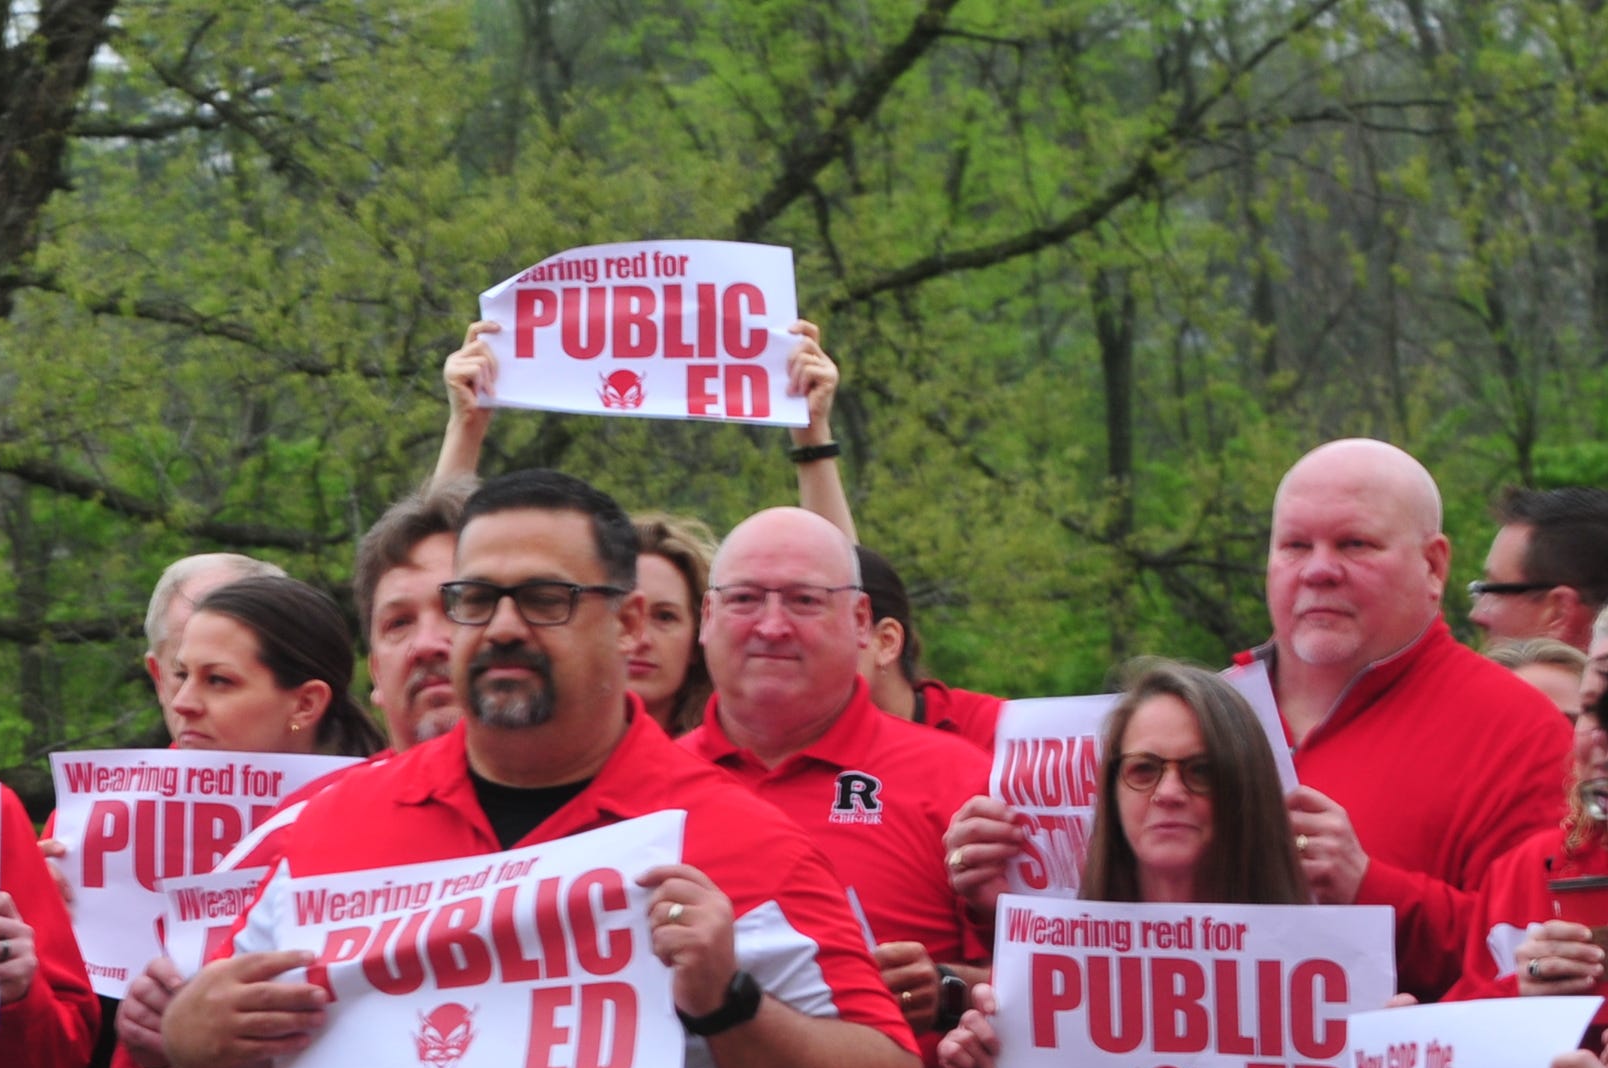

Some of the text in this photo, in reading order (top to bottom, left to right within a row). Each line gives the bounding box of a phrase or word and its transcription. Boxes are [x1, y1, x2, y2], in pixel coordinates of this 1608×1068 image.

[605, 252, 647, 279] red
[652, 251, 689, 277] for
[515, 282, 769, 360] PUBLIC
[686, 364, 770, 418] ED
[64, 762, 282, 797] Wearing red for
[832, 770, 883, 814] R
[295, 857, 539, 926] Wearing red for
[307, 868, 633, 1002] PUBLIC
[1007, 908, 1247, 952] Wearing red for
[1032, 953, 1348, 1060] PUBLIC
